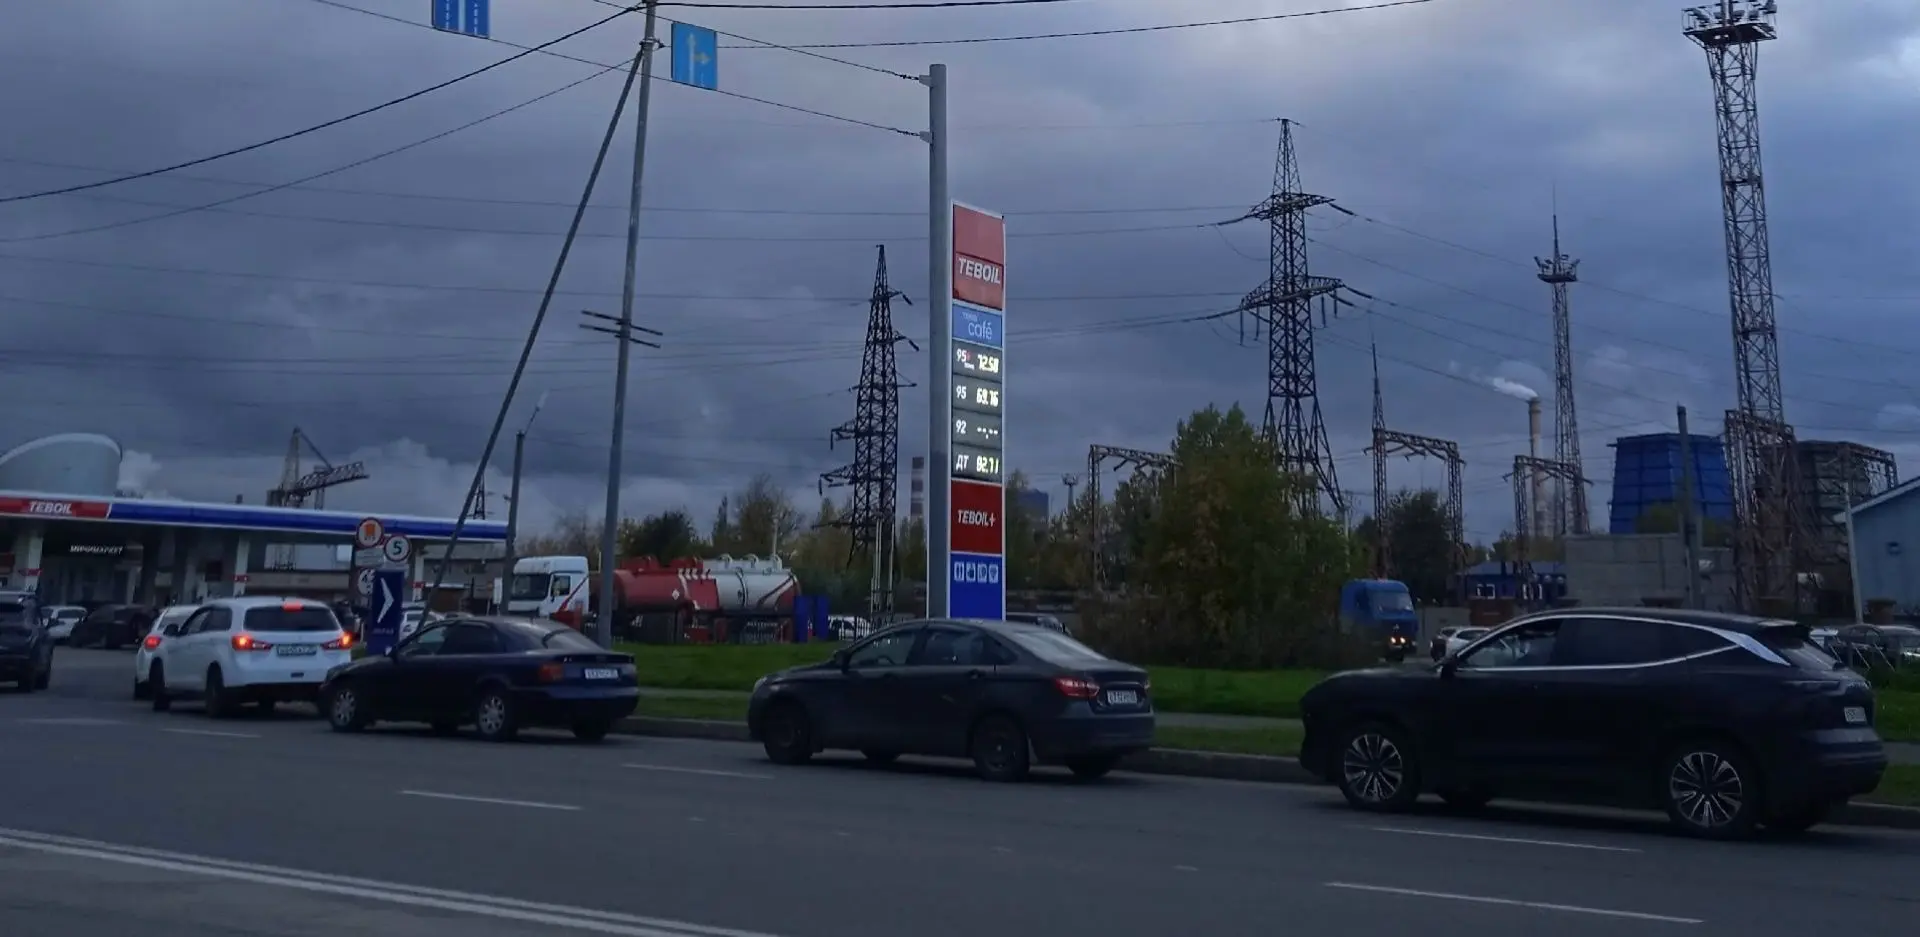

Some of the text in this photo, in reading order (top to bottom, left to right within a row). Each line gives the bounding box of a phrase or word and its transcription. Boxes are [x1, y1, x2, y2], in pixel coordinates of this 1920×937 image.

[958, 257, 1001, 284] TEBOIL
[968, 320, 993, 341] café
[956, 385, 967, 400] 95
[955, 419, 967, 434] 92
[956, 454, 969, 471] ДТ
[29, 501, 72, 514] TEBOIL
[393, 541, 402, 555] 5
